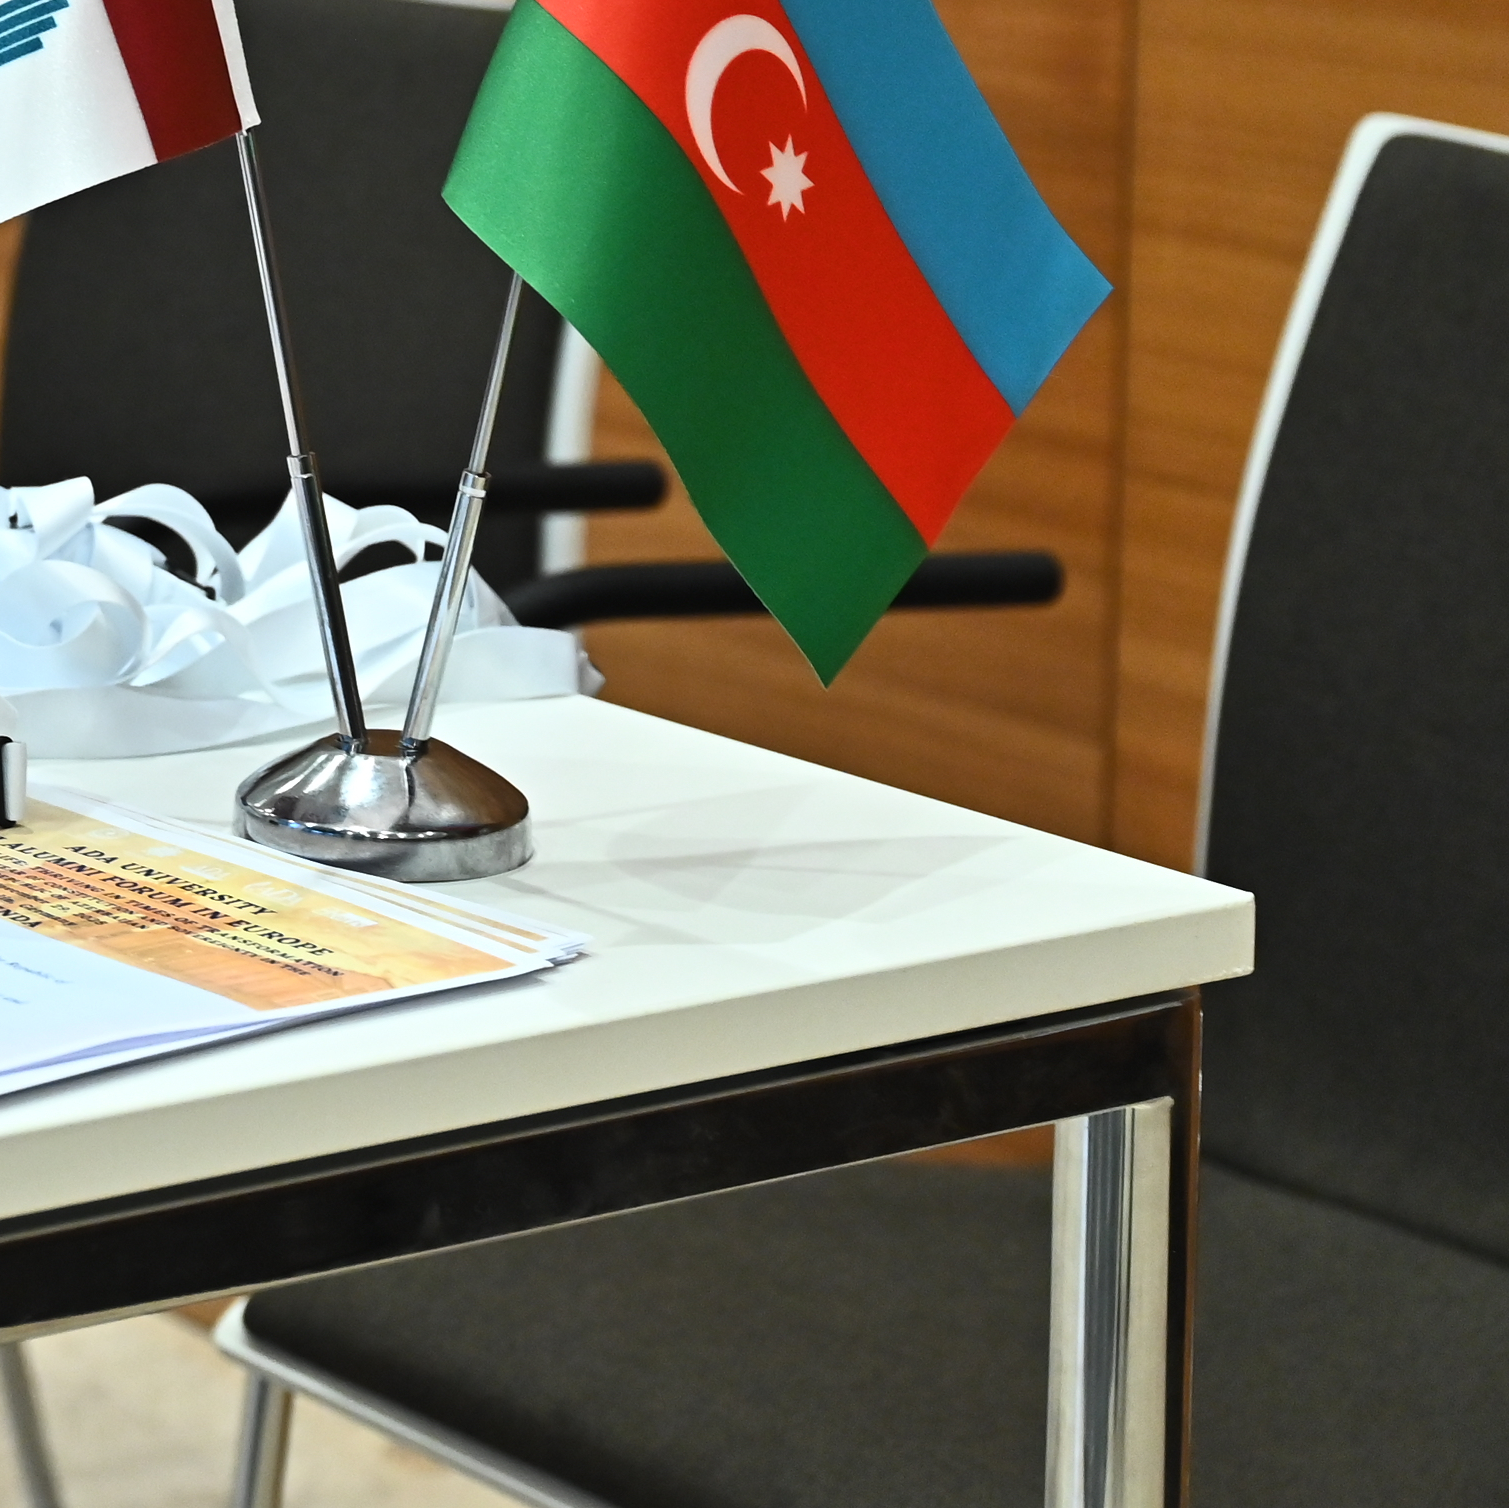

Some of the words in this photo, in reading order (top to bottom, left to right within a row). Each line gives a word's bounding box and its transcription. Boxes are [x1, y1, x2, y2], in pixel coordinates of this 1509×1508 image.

[0, 843, 105, 876] ALUMNI
[100, 876, 194, 908] FORUM
[191, 908, 229, 919] IN
[224, 920, 333, 955] EUROPE
[65, 847, 118, 863] ADA
[121, 863, 276, 914] UNIVERSITY
